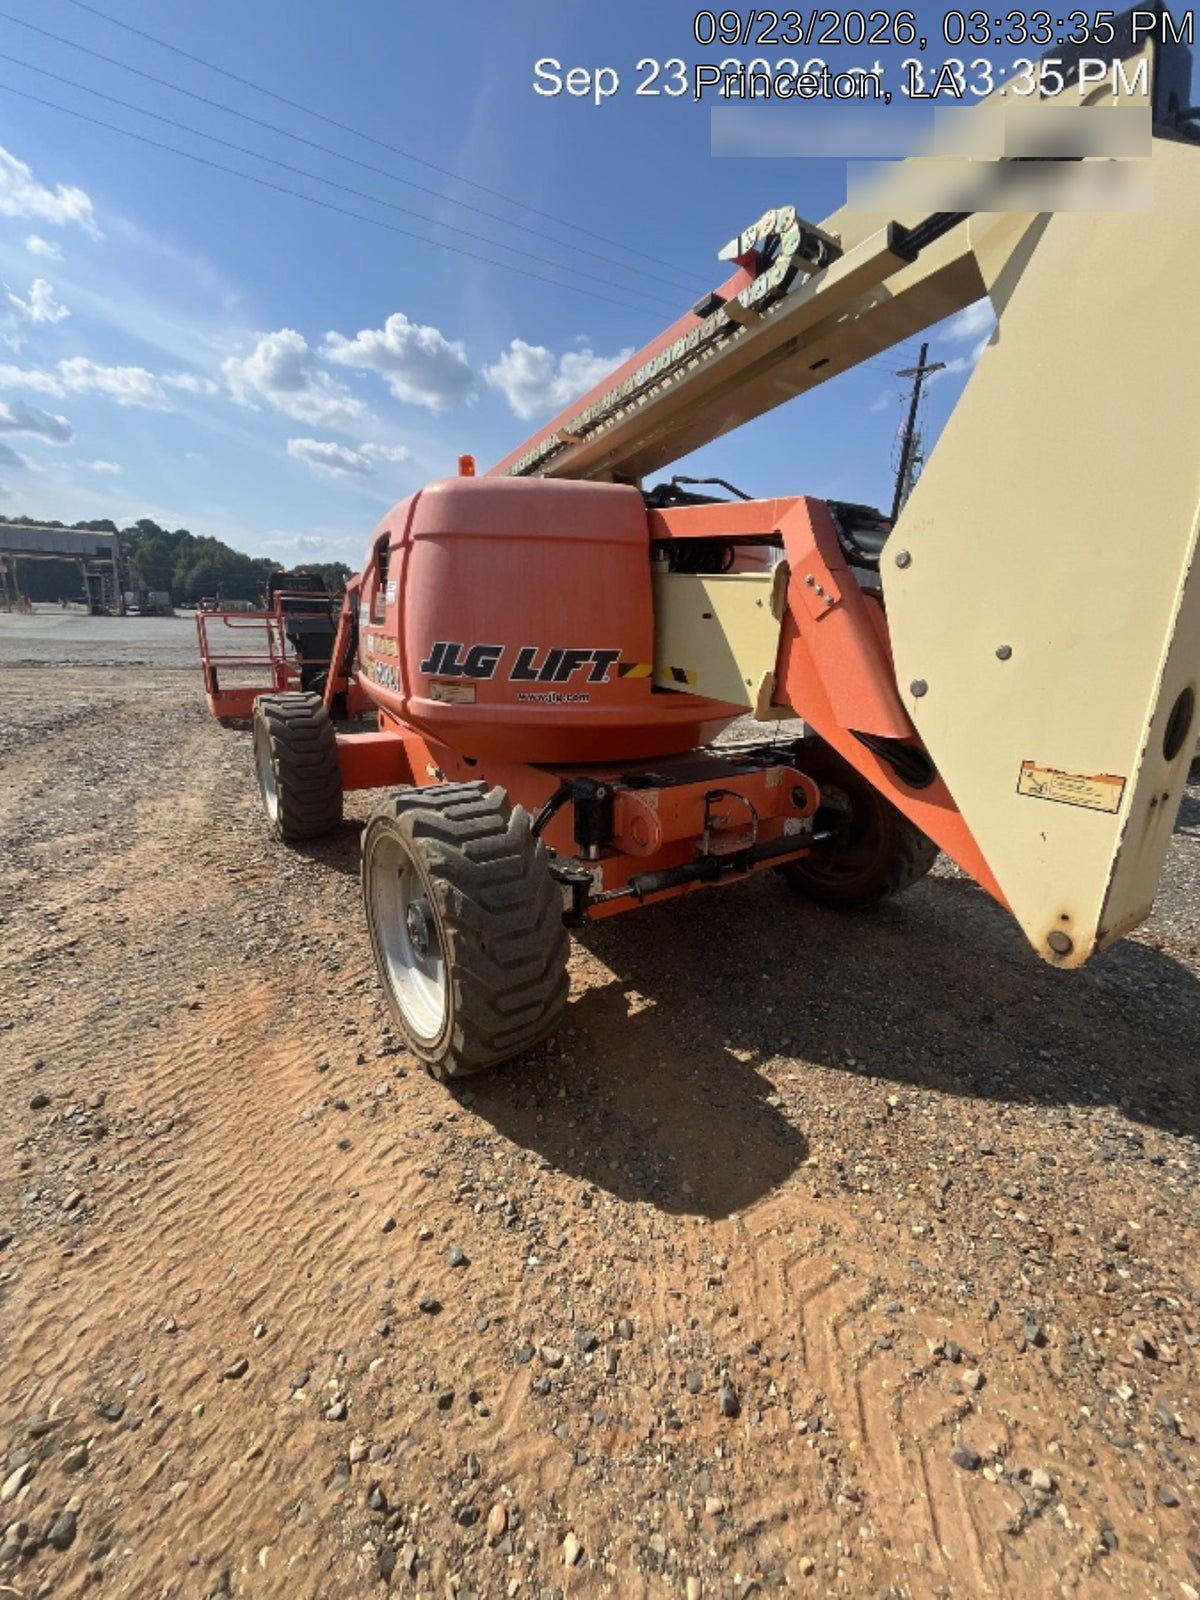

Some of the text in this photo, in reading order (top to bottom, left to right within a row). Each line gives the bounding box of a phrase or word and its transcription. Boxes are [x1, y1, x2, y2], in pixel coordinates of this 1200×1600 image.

[420, 642, 505, 680] JLG
[508, 646, 623, 684] LIFT
[517, 691, 590, 704] www.jlg.com
